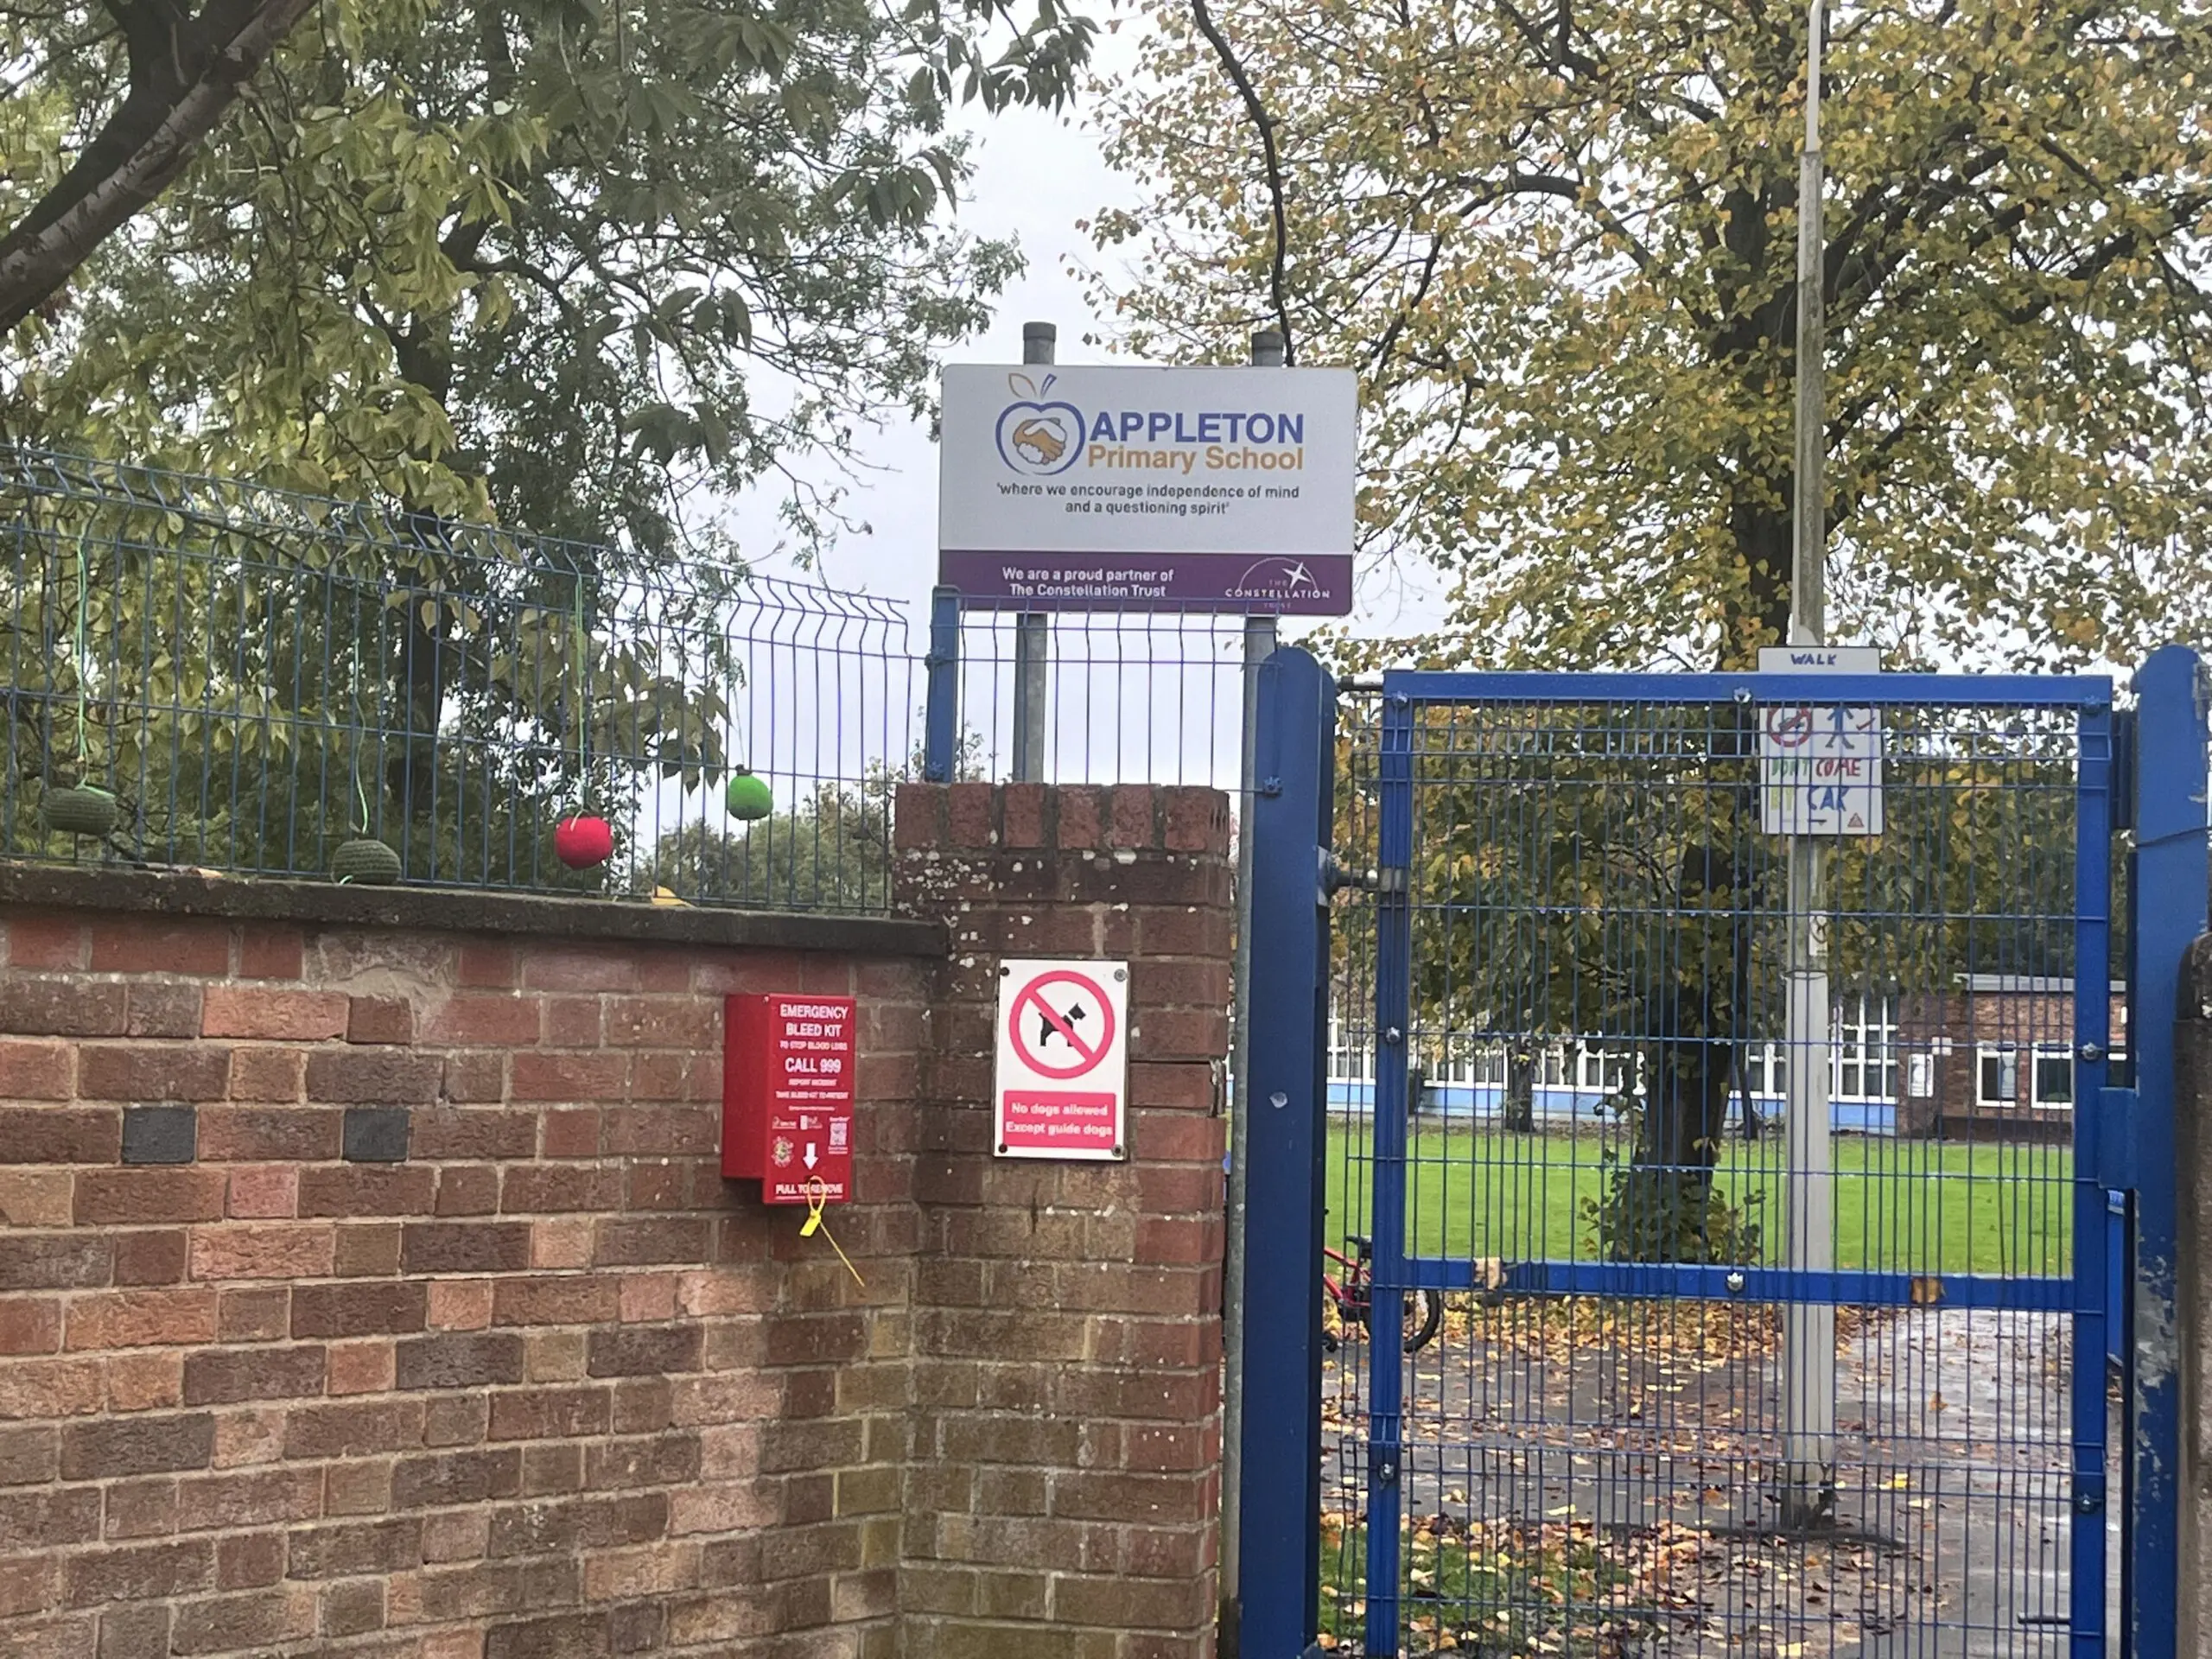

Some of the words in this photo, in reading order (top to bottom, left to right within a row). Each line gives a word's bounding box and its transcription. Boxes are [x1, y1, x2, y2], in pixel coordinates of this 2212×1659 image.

[1090, 412, 1304, 443] APPLETON
[1089, 445, 1196, 474] Primary
[1205, 446, 1304, 470] School
[1046, 485, 1066, 496] we
[1071, 486, 1143, 499] encourage
[1147, 484, 1244, 499] independence
[1248, 485, 1262, 498] of
[1265, 486, 1300, 498] mind
[1065, 500, 1090, 513] and
[1094, 503, 1103, 512] a
[1106, 501, 1187, 516] questioning
[1002, 567, 1024, 580] We
[1027, 569, 1049, 580] are
[1053, 570, 1060, 580] a
[1064, 568, 1103, 582] proud
[1106, 569, 1156, 582] partner
[1160, 569, 1174, 582] of
[1009, 583, 1033, 596] The
[1037, 583, 1128, 596] Constellation
[1131, 584, 1166, 597] Trust
[1224, 588, 1331, 599] CONSTELLATION
[1790, 653, 1836, 665] WALK
[1815, 757, 1861, 777] COME
[1807, 785, 1851, 811] CAR
[779, 1003, 849, 1019] EMERGENCY
[785, 1022, 822, 1036] BLEED
[823, 1024, 842, 1037] KIT
[785, 1058, 817, 1072] CALL
[819, 1058, 842, 1073] 999
[1011, 1103, 1028, 1114] No
[1030, 1103, 1059, 1116] dogs
[1063, 1104, 1108, 1116] allowed
[1005, 1122, 1046, 1135] Except
[1048, 1122, 1080, 1136] guide
[1084, 1123, 1113, 1137] dogs
[775, 1184, 797, 1194] PULL
